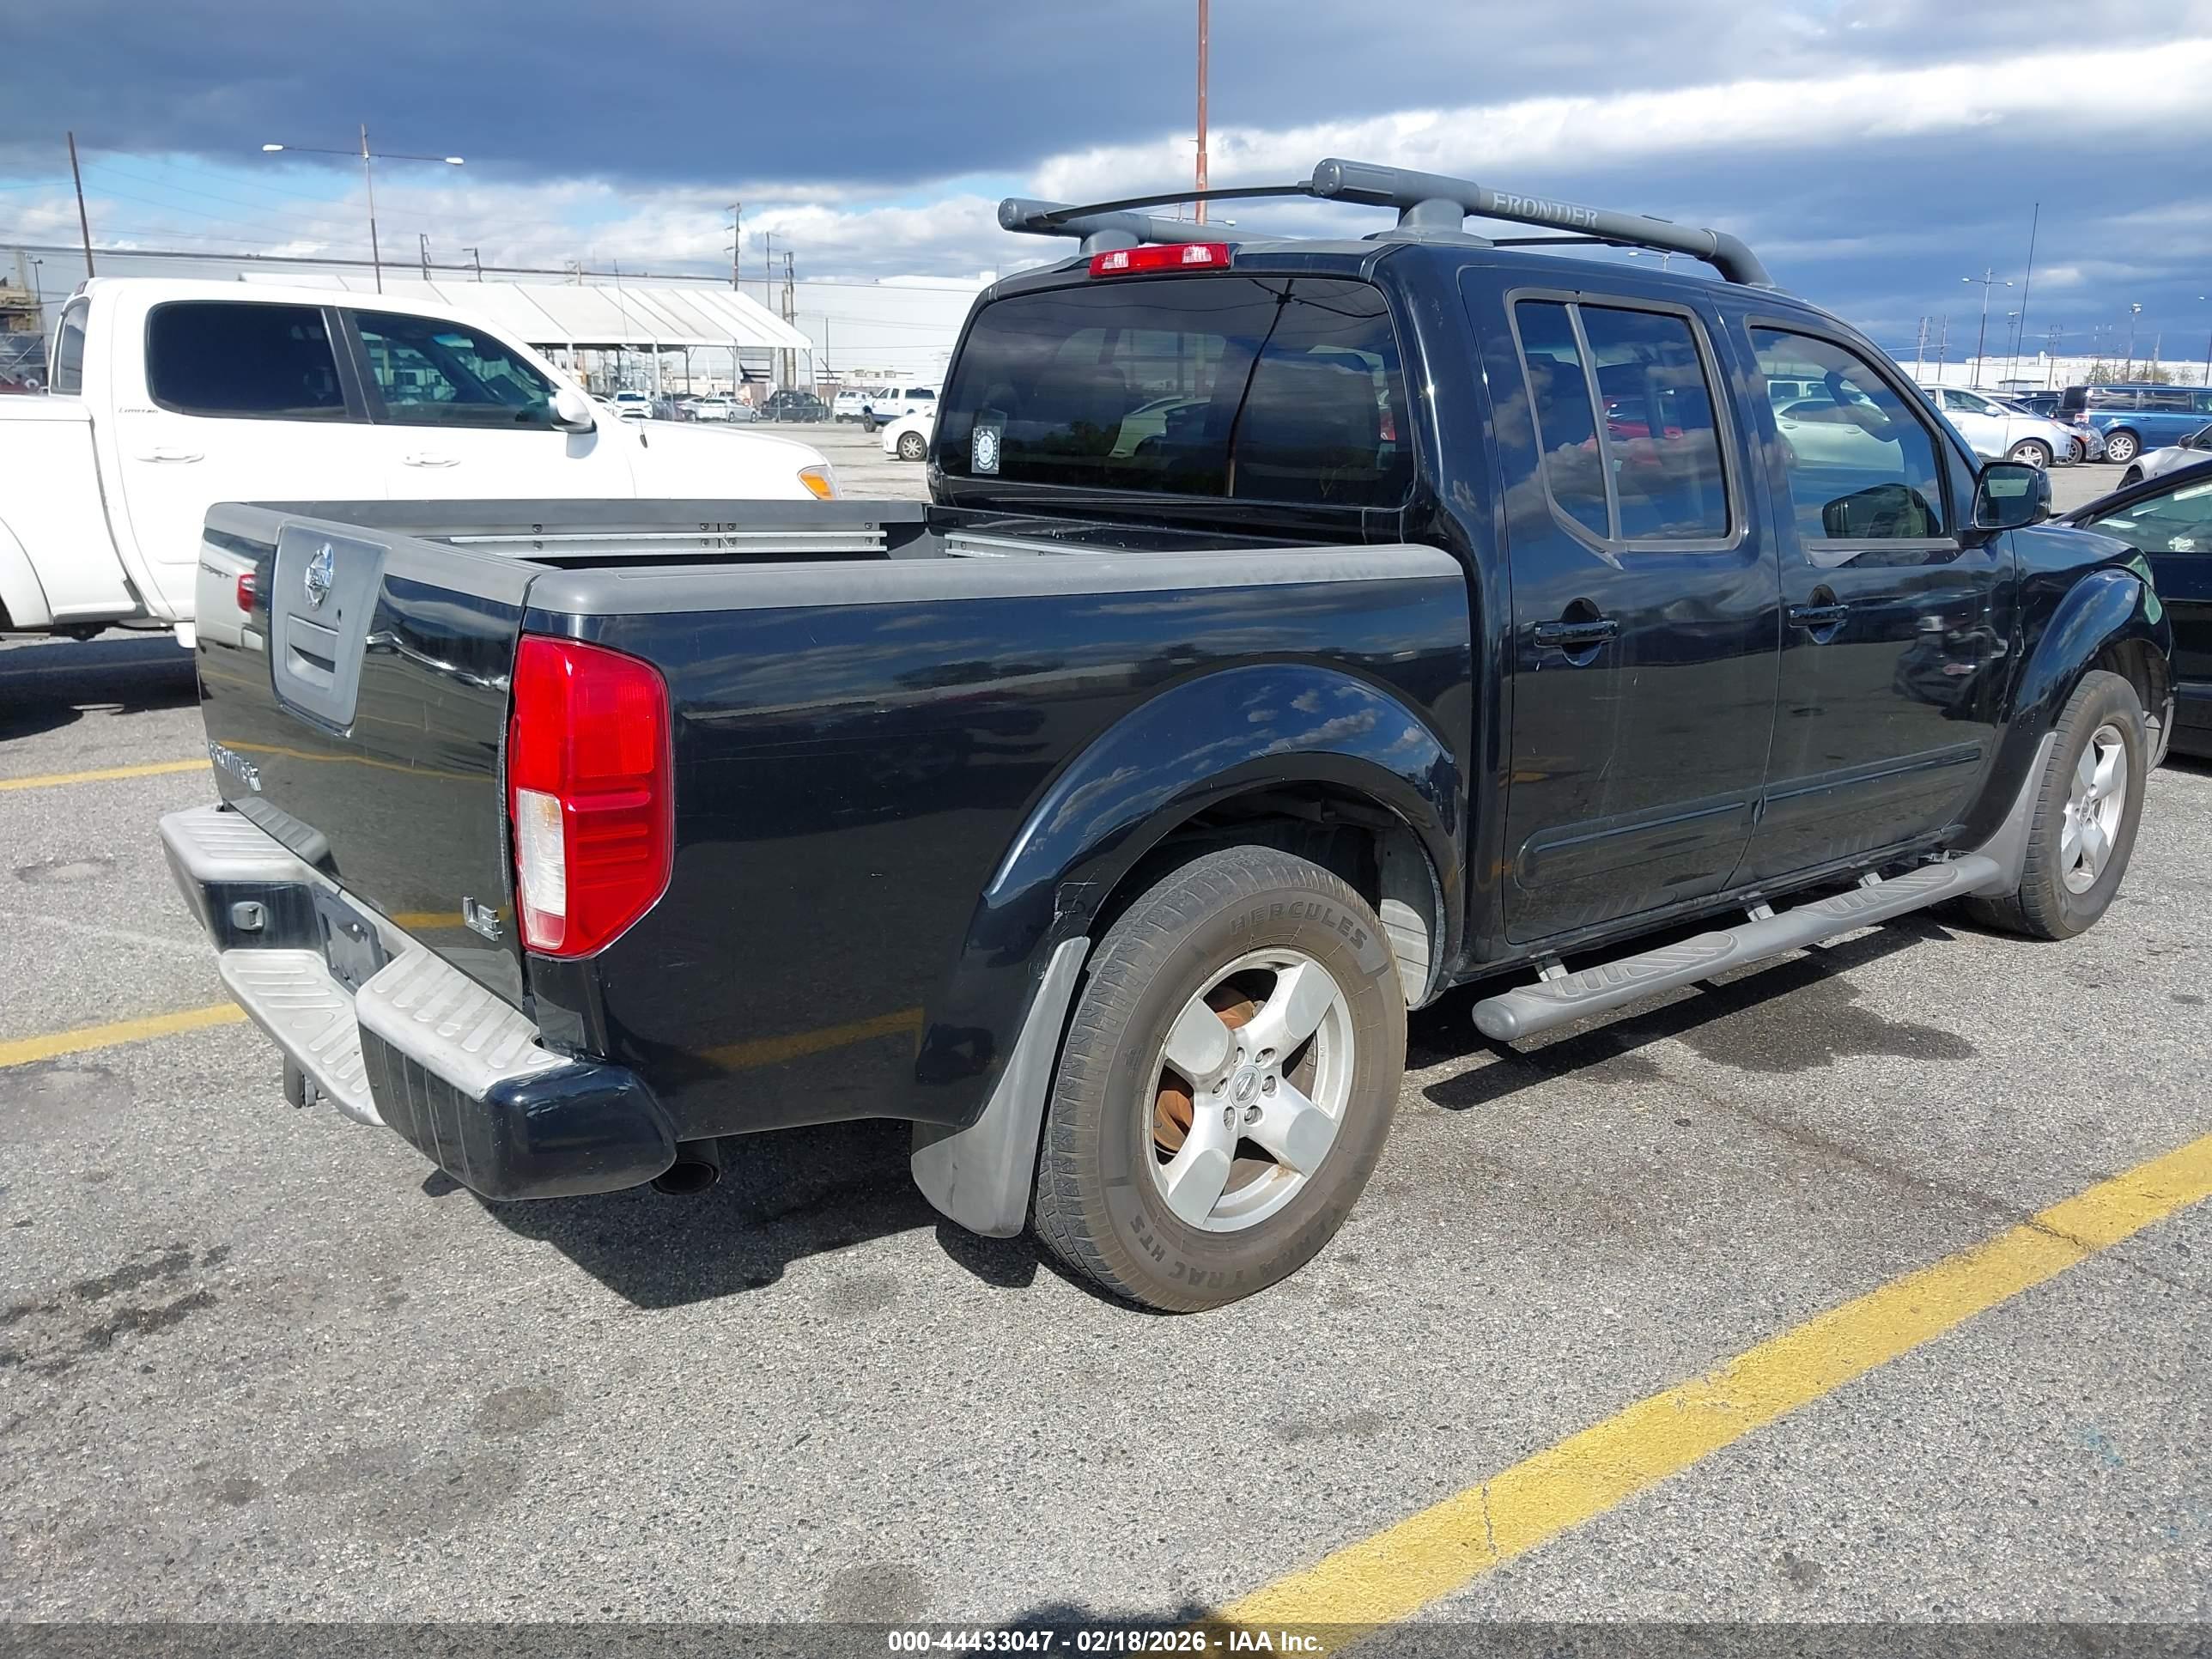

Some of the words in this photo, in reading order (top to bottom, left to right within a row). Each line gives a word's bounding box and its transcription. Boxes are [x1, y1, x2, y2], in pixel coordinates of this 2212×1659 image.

[1492, 191, 1599, 228] FRONTIER
[463, 896, 503, 942] LE
[1229, 901, 1368, 951] HERCULES
[1129, 1214, 1167, 1263] HTS
[1168, 1261, 1248, 1288] TRAC
